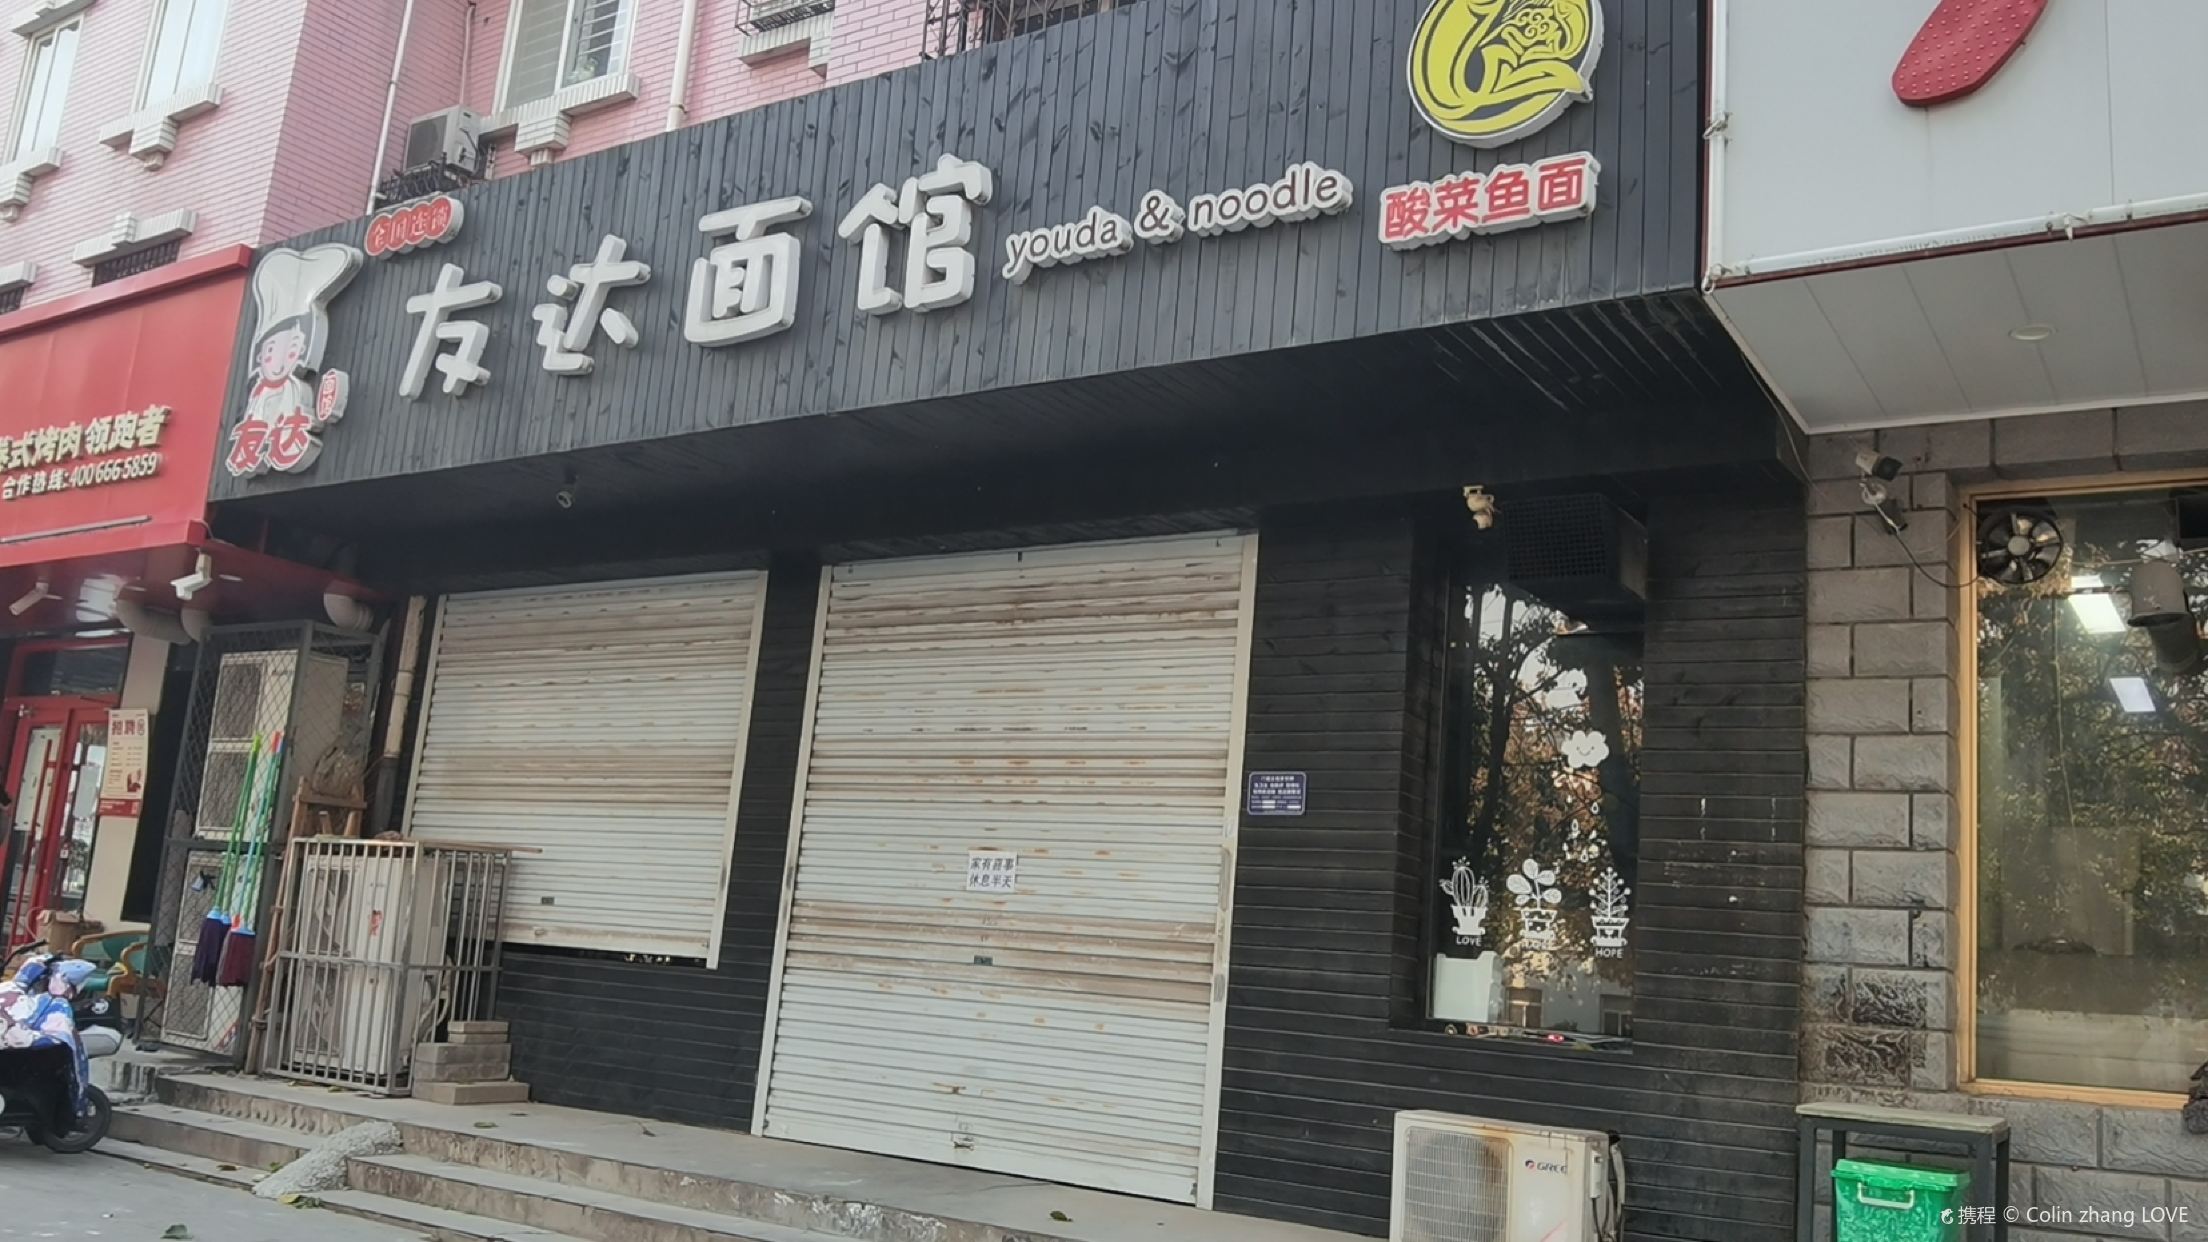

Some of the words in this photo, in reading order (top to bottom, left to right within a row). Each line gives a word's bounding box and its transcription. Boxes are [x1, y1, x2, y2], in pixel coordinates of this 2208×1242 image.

[1004, 208, 1124, 279] youda
[1137, 193, 1174, 236] &
[1190, 164, 1341, 227] noodle
[1384, 158, 1588, 240] 酸菜鱼面
[400, 154, 992, 398] 友达面馆
[85, 404, 171, 455] 领跑者
[230, 405, 311, 470] 友达
[1456, 935, 1482, 947] LOVE
